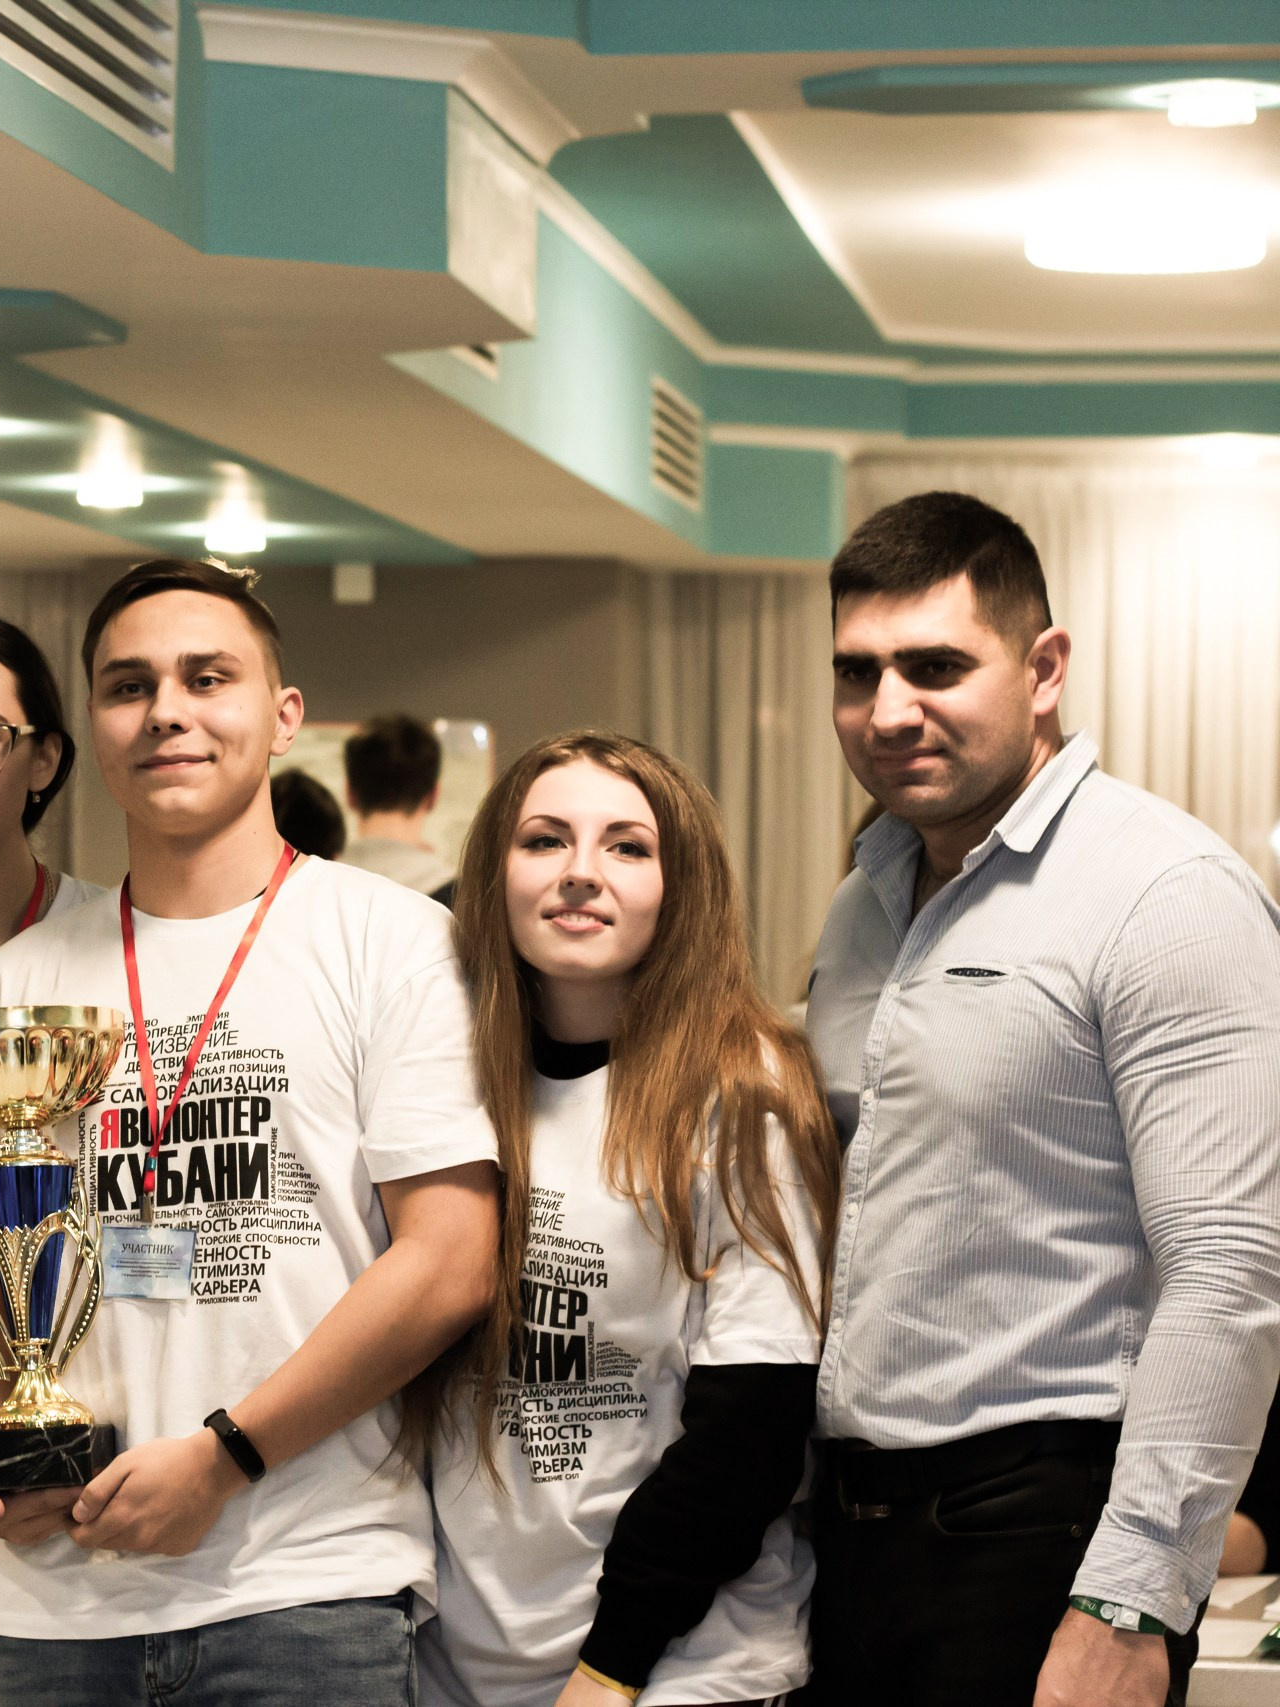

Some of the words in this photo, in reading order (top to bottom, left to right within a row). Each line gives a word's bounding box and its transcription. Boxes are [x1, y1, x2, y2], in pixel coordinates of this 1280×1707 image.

[229, 1063, 286, 1074] ПОЗИЦИЯ
[89, 1123, 97, 1217] ИНИЦИАТИВНОСТЬ
[278, 1162, 304, 1171] НОСТЬ
[278, 1179, 320, 1190] ПРАКТИКА
[206, 1206, 309, 1219] САМОКРИТИЧНОСТЬ
[241, 1217, 322, 1232] ДИСЦИПЛИНА
[245, 1233, 320, 1246] СПОСОБНОСТИ
[121, 1243, 174, 1254] УЧАСТНИК
[194, 1245, 271, 1263] ЕННОСТЬ
[551, 1251, 605, 1270] ПОЗИЦИЯ
[190, 1278, 261, 1296] КАРЬЕРА
[521, 1382, 633, 1398] АМОКРИТИЧНОСТЬ
[558, 1394, 647, 1410] ДИСЦИПЛИНА
[564, 1408, 648, 1422] СПОСОБНОСТИ
